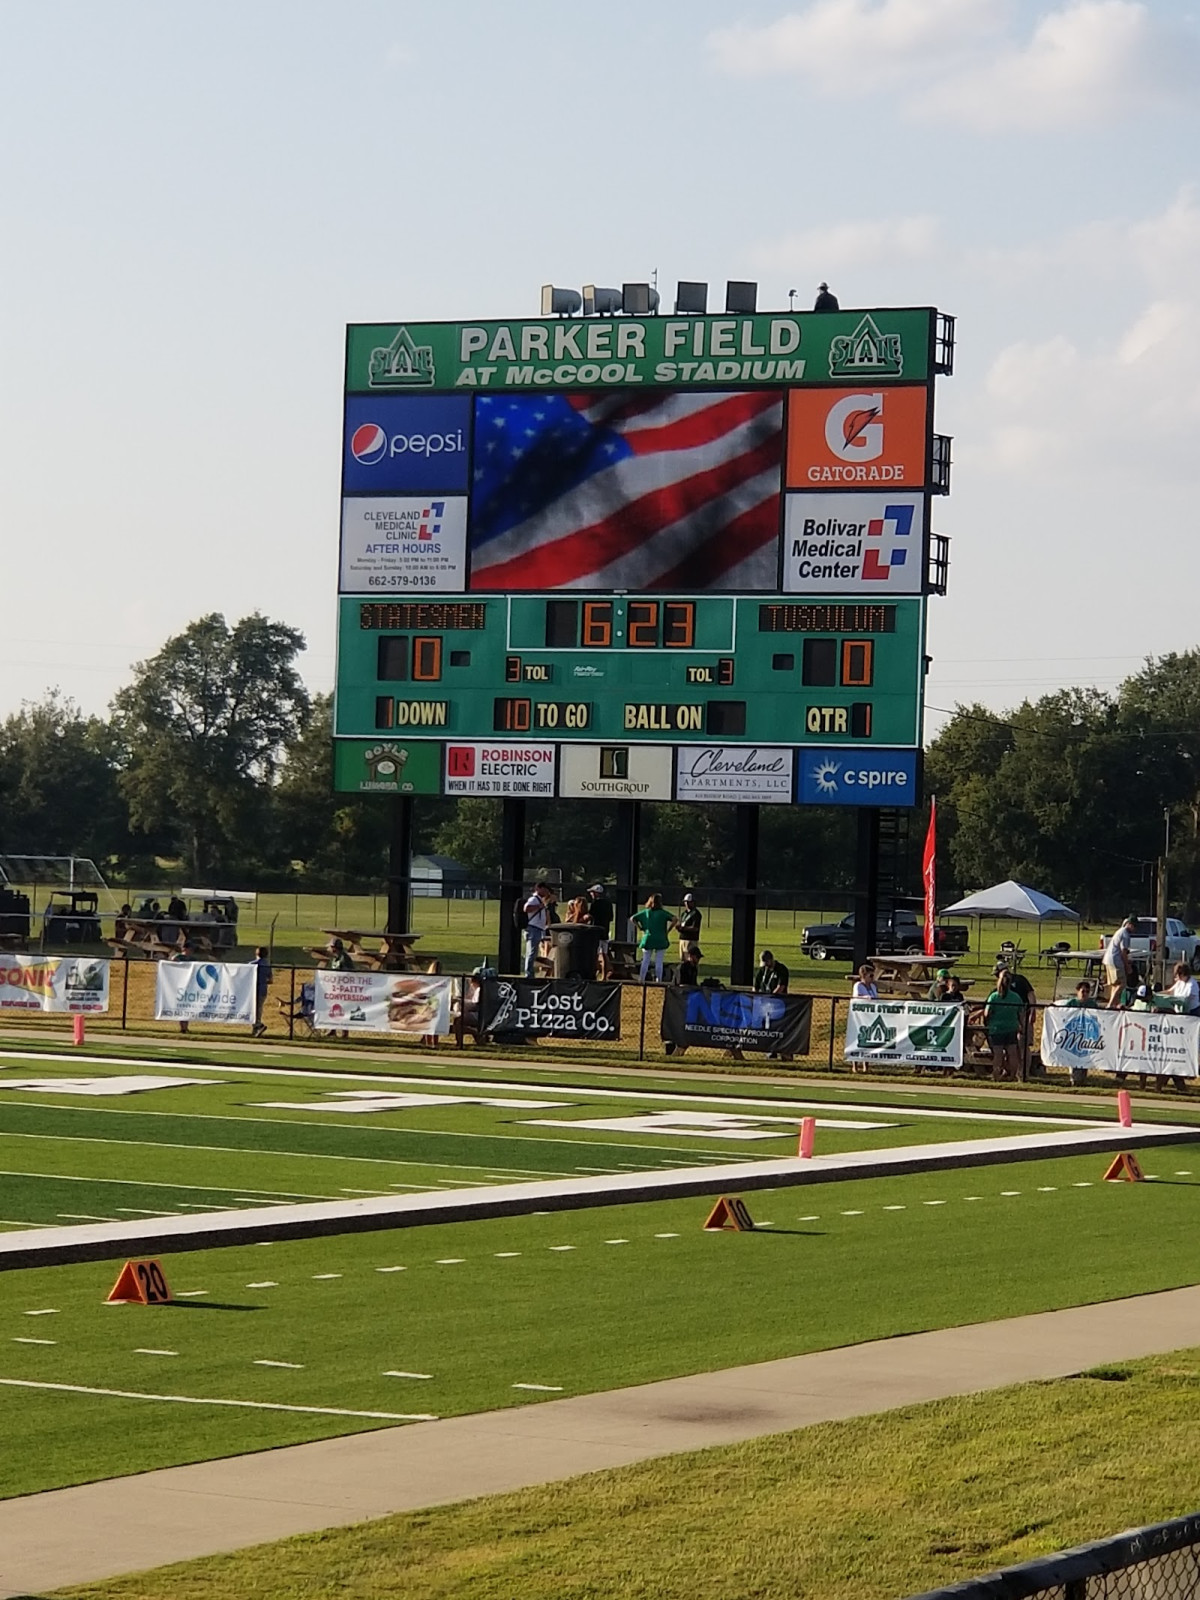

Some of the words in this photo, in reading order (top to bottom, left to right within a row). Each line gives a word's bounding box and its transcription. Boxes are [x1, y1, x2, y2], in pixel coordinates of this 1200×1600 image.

[460, 323, 647, 362] PARKER
[664, 319, 801, 357] FIELD
[829, 313, 903, 368] STATE
[455, 366, 497, 386] AT
[505, 363, 644, 385] McCOOL
[654, 359, 806, 382] STADIUM
[824, 392, 884, 463] G
[390, 429, 465, 458] pepsi
[807, 465, 904, 482] GATORADE
[363, 511, 421, 521] CLEVELAND
[375, 521, 418, 531] MEDICAL
[802, 519, 866, 537] Bolivar
[386, 531, 417, 541] CLINIC
[365, 543, 400, 554] AFTER
[402, 543, 442, 554] HOURS
[791, 539, 863, 557] Medical
[798, 560, 860, 579] Center
[368, 575, 437, 586] 662-579-0136
[360, 604, 485, 629] STATESMEN
[767, 605, 886, 631] TUSCULUM
[413, 637, 442, 681] 0
[842, 640, 873, 686] 0
[508, 657, 521, 682] 3
[525, 665, 549, 681] TOL
[688, 667, 713, 683] TOL
[719, 659, 734, 685] 3
[399, 701, 447, 726] DOWN
[505, 699, 531, 731] 10
[537, 703, 559, 728] TO
[565, 704, 589, 728] GO
[624, 704, 672, 730] BALL
[676, 705, 702, 730] ON
[807, 707, 848, 733] QTR
[481, 749, 553, 763] ROBINSON
[690, 748, 785, 778] Cleveland
[481, 763, 538, 777] ELECTRIC
[857, 770, 908, 789] spire
[448, 780, 467, 791] WHEN
[468, 781, 476, 791] IT
[477, 781, 491, 791] HAS
[492, 781, 501, 791] TO
[502, 782, 511, 792] BE
[512, 782, 531, 792] DONE
[532, 782, 553, 793] RIGHT
[683, 778, 761, 788] APARTMENTS,
[766, 780, 788, 788] LLC
[332, 984, 364, 993] 2-PATTY
[337, 975, 356, 985] FOR
[358, 976, 373, 985] THE
[176, 987, 237, 1005] Statewide
[530, 989, 583, 1011] Lost
[685, 989, 786, 1029] NSP
[852, 1003, 876, 1013] SOUTH
[877, 1004, 906, 1014] STREET
[907, 1006, 947, 1016] PHARMACY
[515, 1008, 578, 1031] Pizza
[581, 1011, 615, 1032] Co.
[1148, 1023, 1186, 1036] Right
[684, 1023, 711, 1033] NEEDLE
[712, 1026, 748, 1036] SPECIALTY
[748, 1029, 784, 1039] PRODUCTS
[711, 1034, 758, 1045] CORPORATION
[1053, 1028, 1106, 1052] Maids
[1148, 1034, 1161, 1043] at
[1148, 1043, 1187, 1055] Home
[137, 1261, 168, 1301] 20
